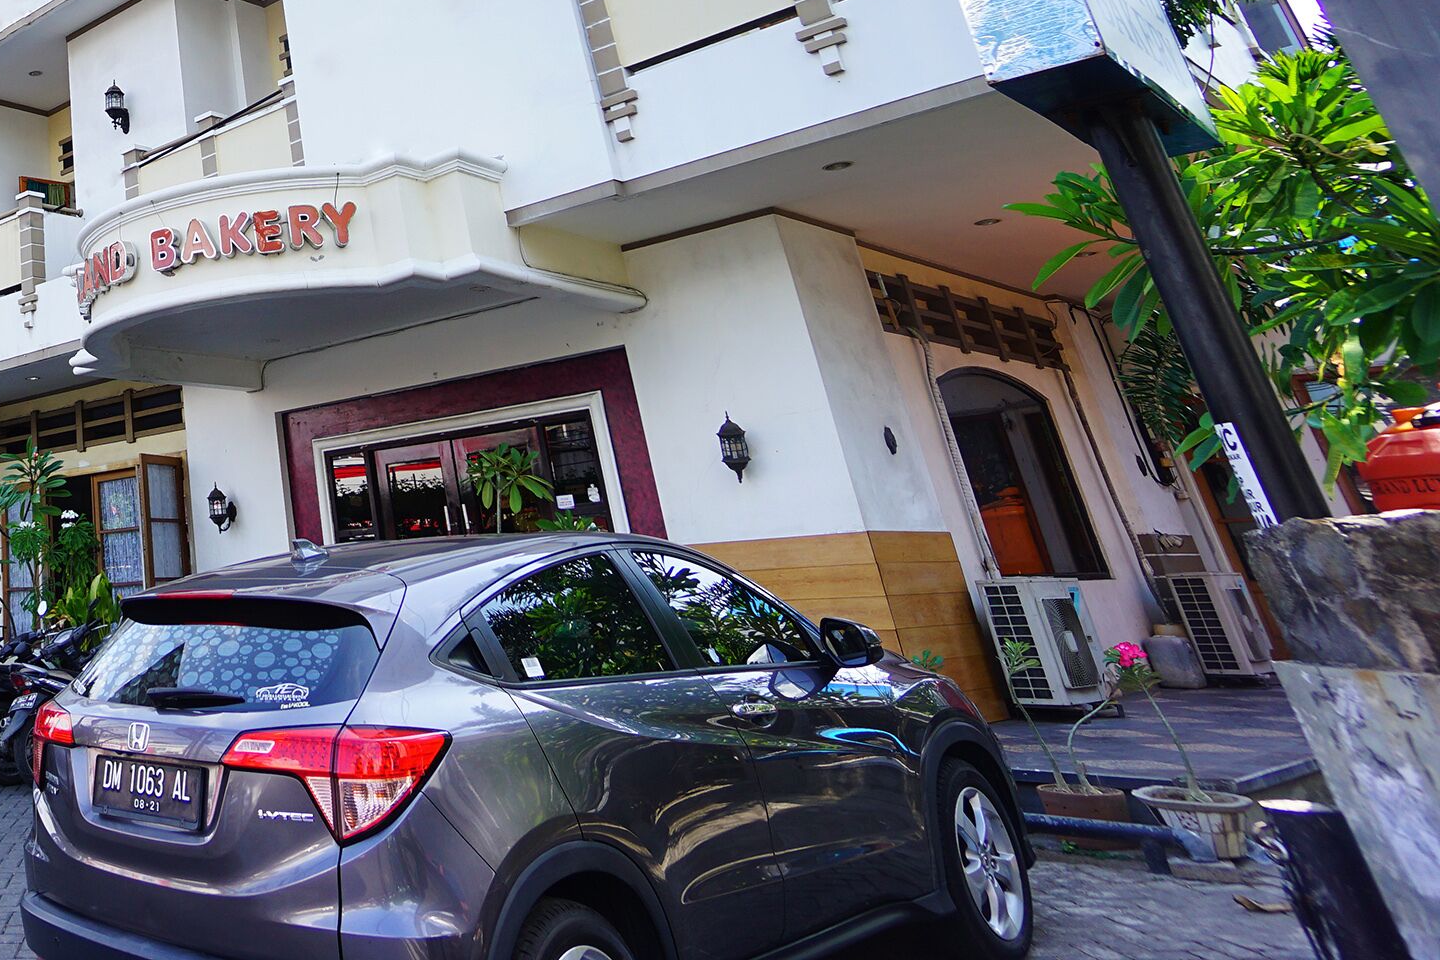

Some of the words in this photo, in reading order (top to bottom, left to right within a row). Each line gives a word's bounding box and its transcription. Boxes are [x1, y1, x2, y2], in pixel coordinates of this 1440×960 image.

[148, 201, 358, 274] BAKERY
[102, 760, 122, 790] DM
[129, 764, 165, 798] 1063
[172, 770, 191, 802] AL
